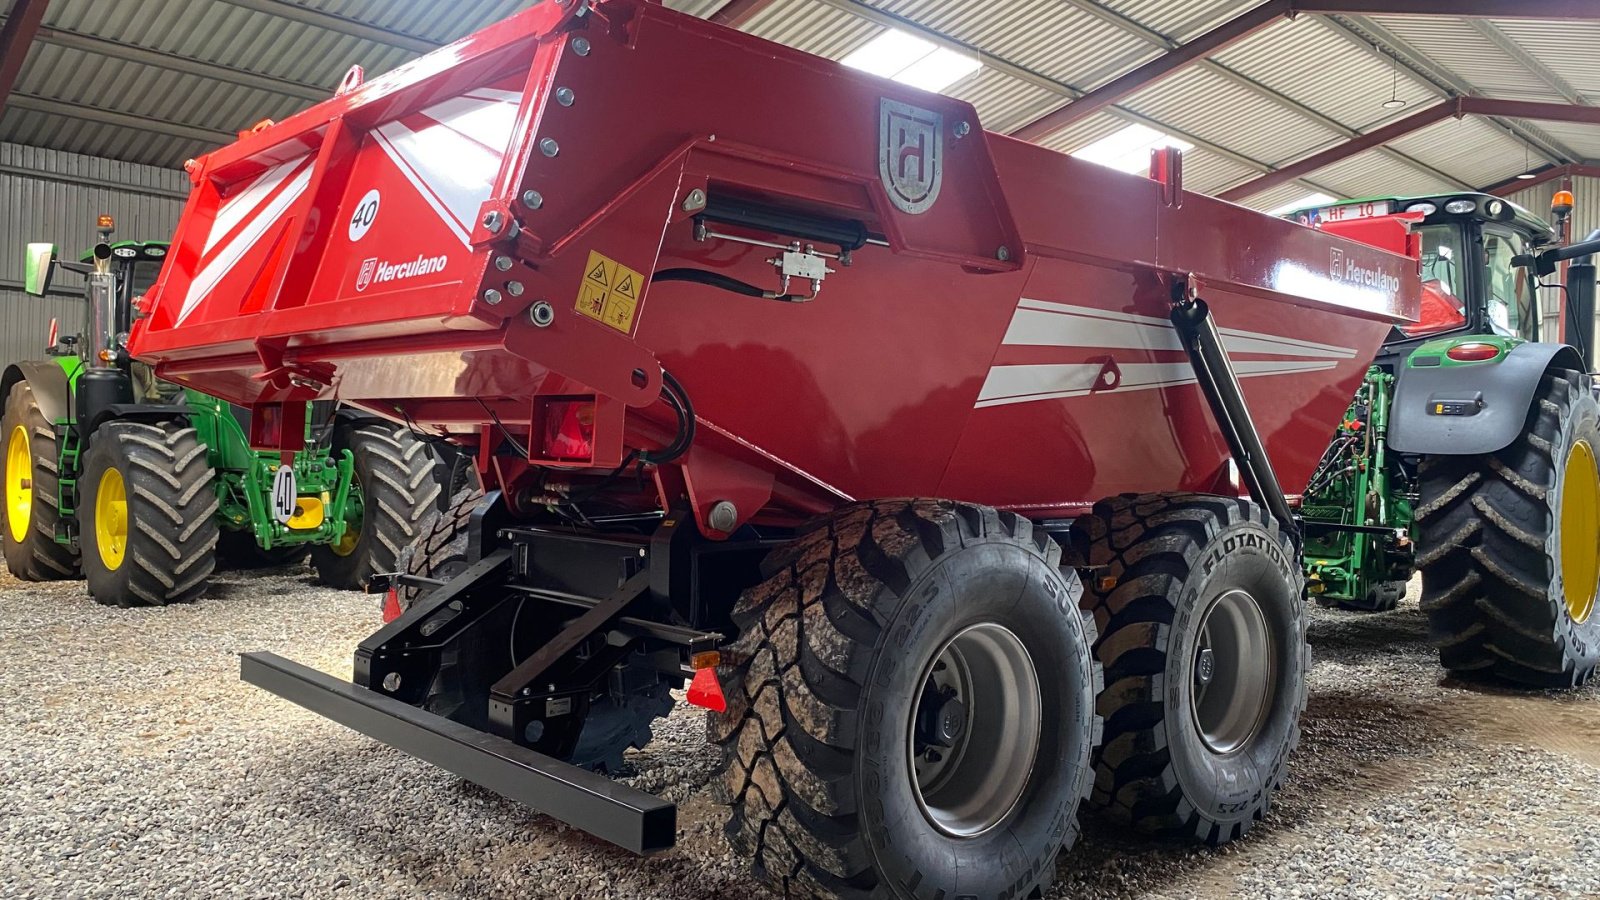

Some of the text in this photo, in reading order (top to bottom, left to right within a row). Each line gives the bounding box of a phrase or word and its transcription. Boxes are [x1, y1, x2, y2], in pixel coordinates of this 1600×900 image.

[351, 200, 378, 229] 40
[1328, 203, 1374, 220] HF 10
[373, 254, 448, 283] Herculano
[1345, 258, 1400, 293] Herculano
[276, 471, 292, 515] 40
[894, 579, 940, 649] 22.5
[1042, 573, 1090, 689] SUPER
[1169, 533, 1290, 711] SUPER FLOTATION
